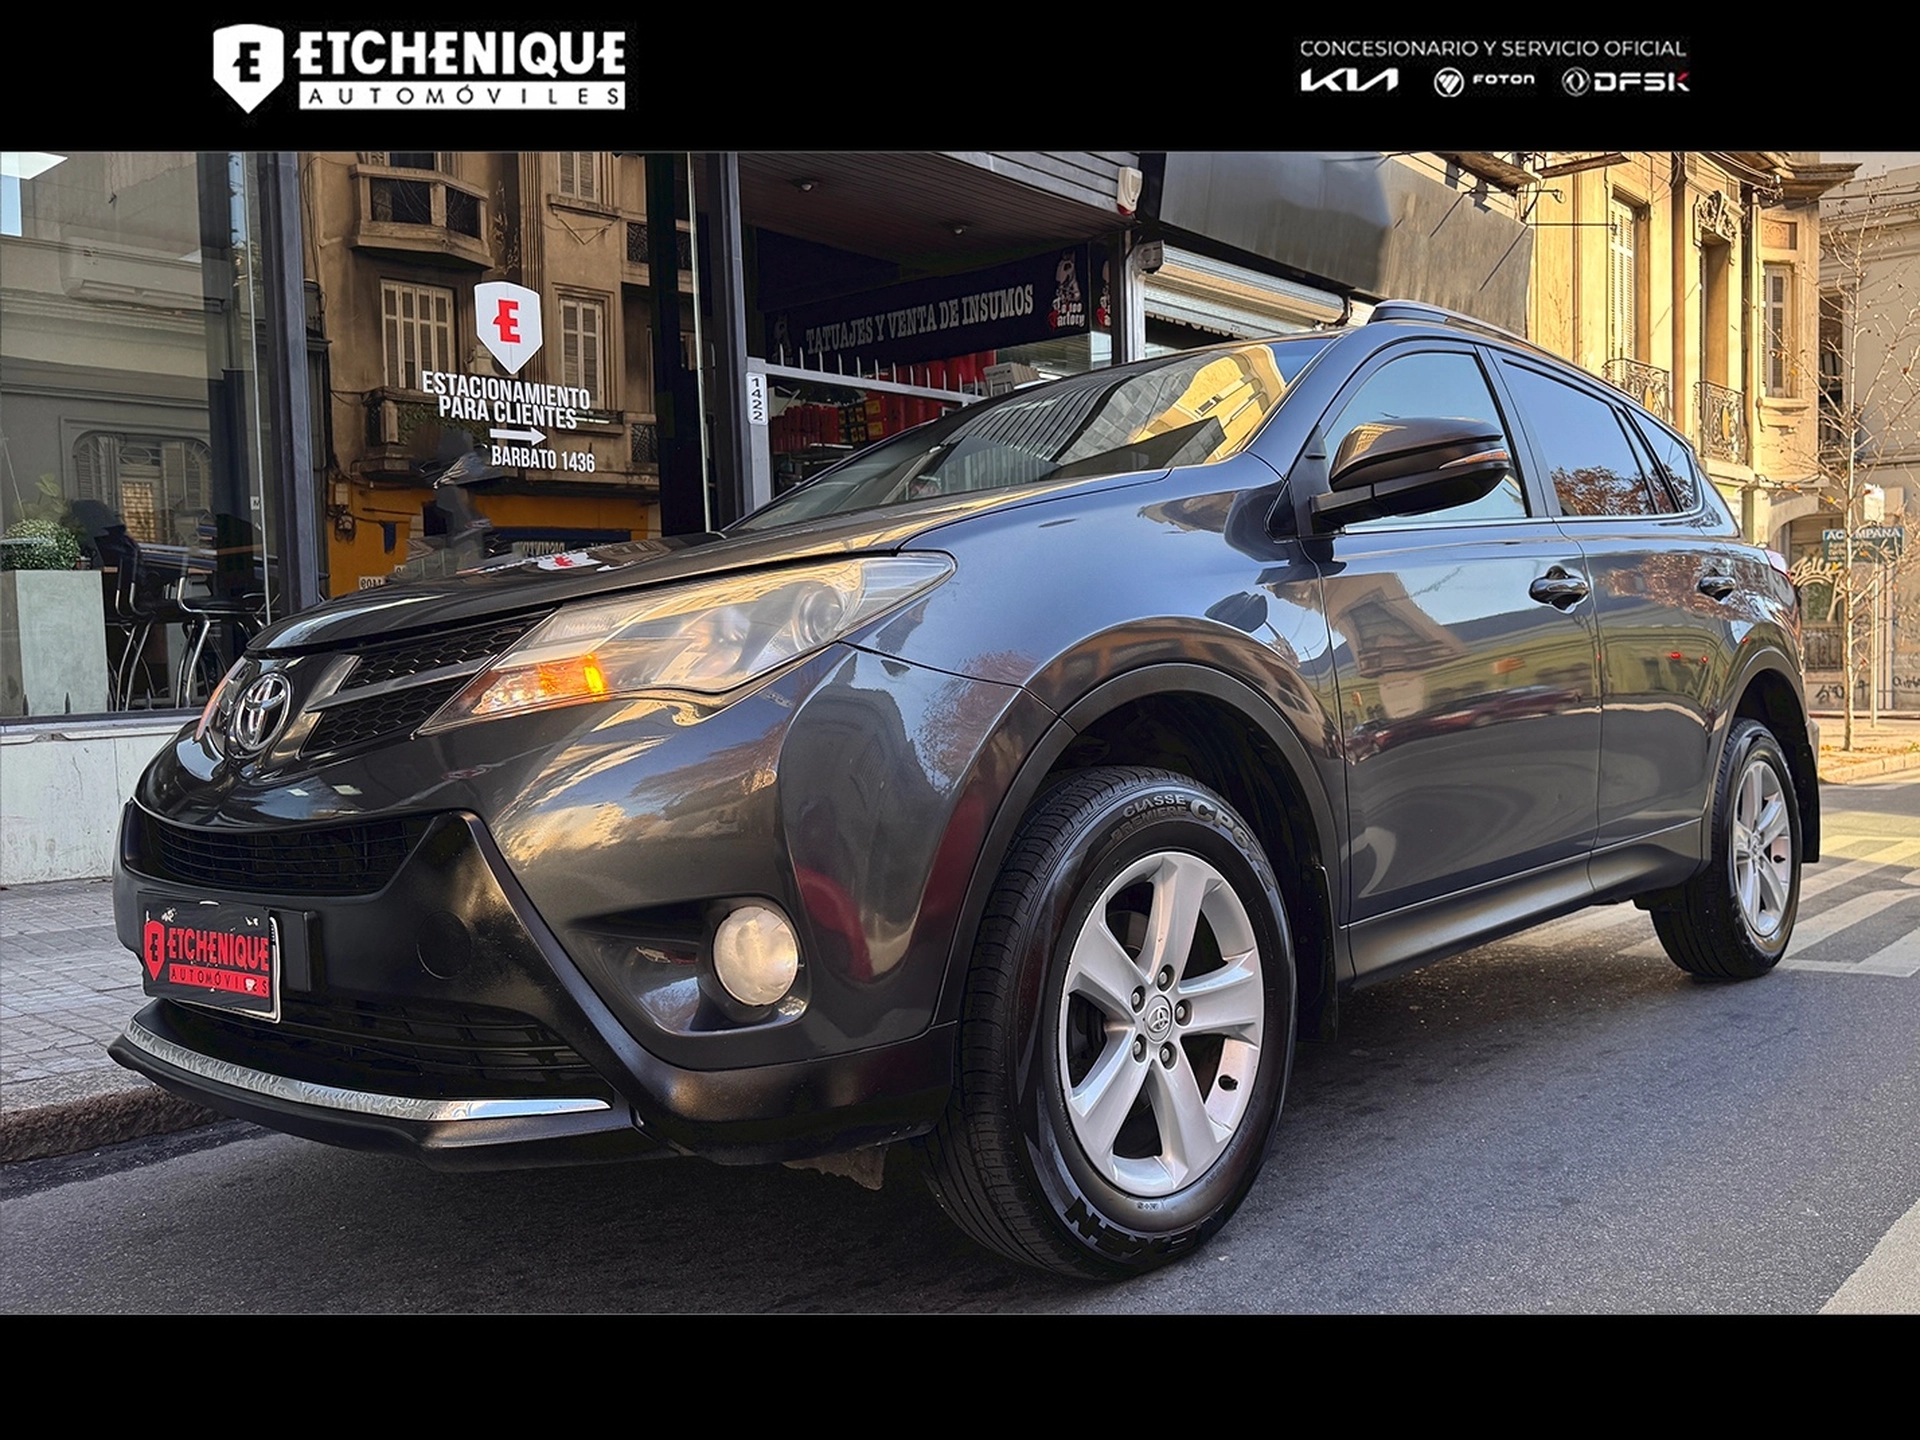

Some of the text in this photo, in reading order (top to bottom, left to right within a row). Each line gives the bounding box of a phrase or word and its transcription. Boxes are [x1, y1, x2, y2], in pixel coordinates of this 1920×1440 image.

[806, 284, 1034, 354] TATUAJES Y VENTA DE INSUMOS
[422, 371, 590, 411] ESTACIONAMIENTO
[751, 377, 763, 421] 1422
[439, 395, 577, 430] PARA CLIENTES
[491, 445, 595, 472] BARBATO 1436
[1110, 806, 1188, 843] PREMIERE
[1123, 794, 1187, 818] CLASSE
[167, 927, 270, 972] ETCHENIQUE
